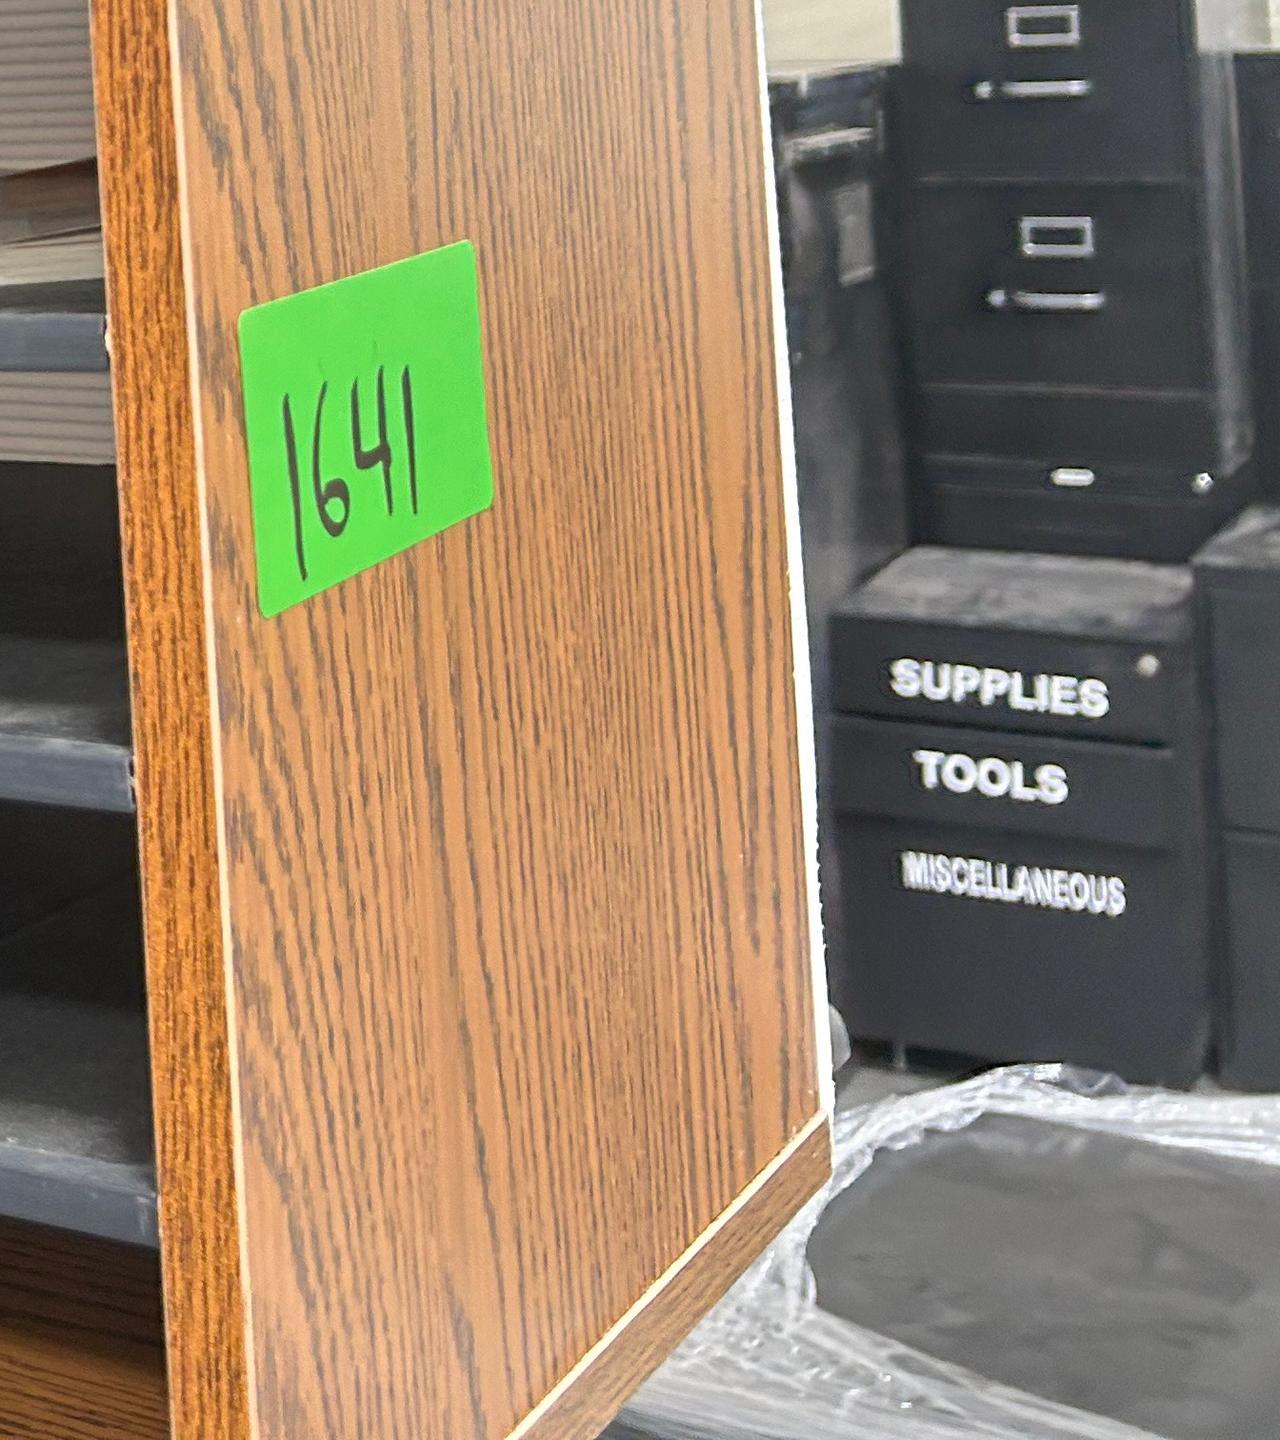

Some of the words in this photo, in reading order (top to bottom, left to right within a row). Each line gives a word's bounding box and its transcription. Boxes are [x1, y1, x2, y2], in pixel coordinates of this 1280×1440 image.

[282, 364, 419, 582] 1641
[890, 657, 1111, 719] SUPPLIES
[912, 749, 1070, 806] TOOLS
[901, 850, 1128, 917] MISCELLANEOUS
